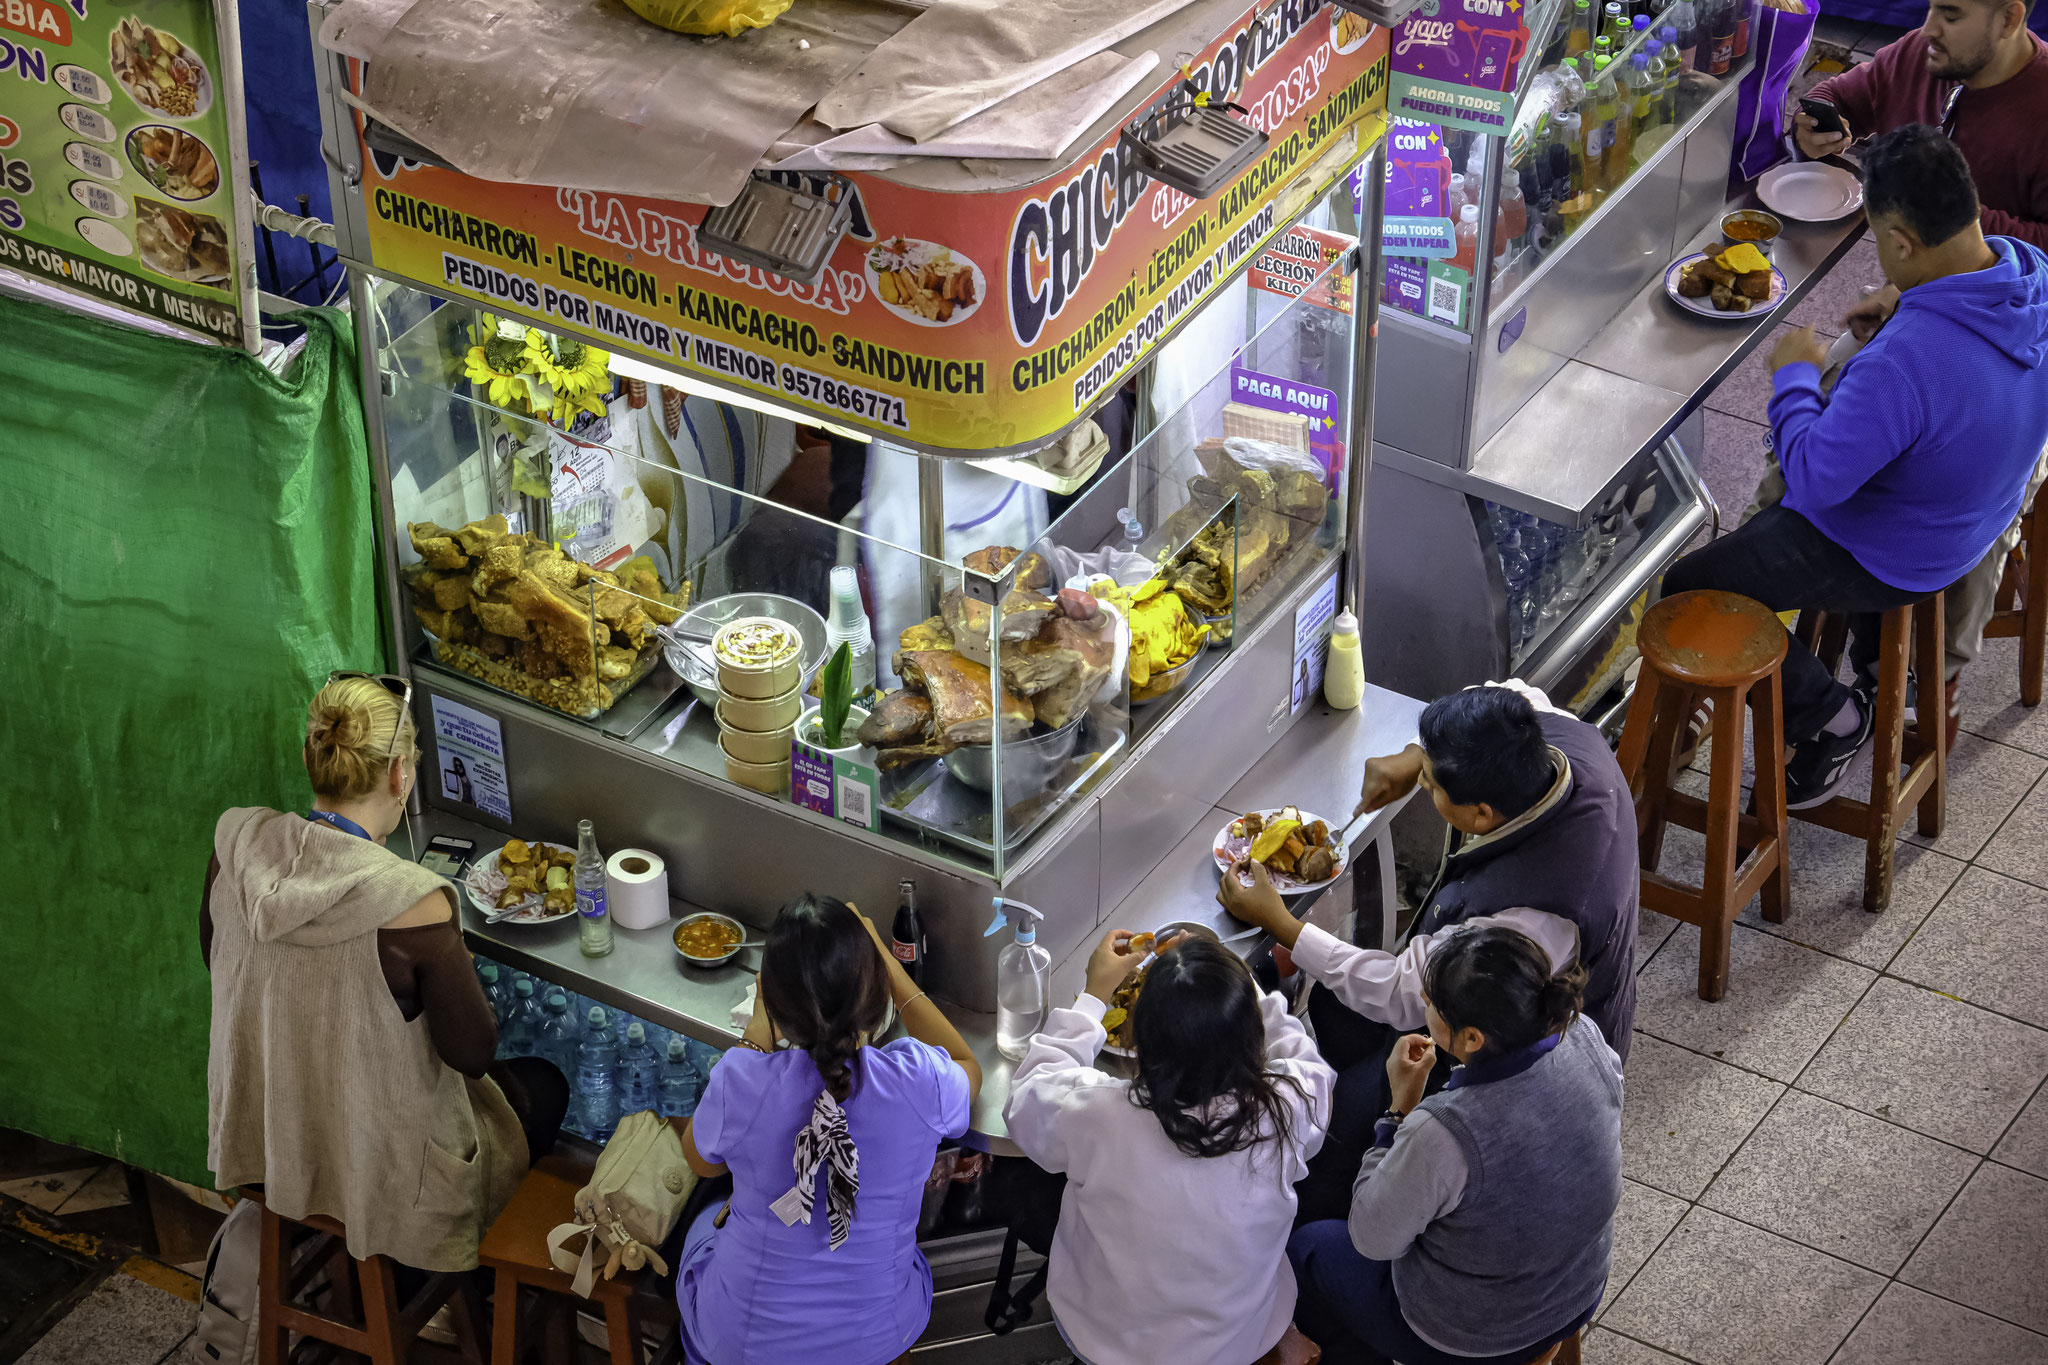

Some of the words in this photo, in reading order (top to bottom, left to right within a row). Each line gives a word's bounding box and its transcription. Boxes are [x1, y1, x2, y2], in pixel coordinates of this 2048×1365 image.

[0, 0, 60, 37] BIA
[1463, 0, 1505, 17] CON
[1396, 19, 1454, 55] yape
[1480, 66, 1496, 78] yape
[1401, 97, 1452, 118] PUEDEN
[1455, 108, 1505, 126] YAPEAR
[1408, 85, 1453, 104] AHORA
[1457, 94, 1501, 113] TODOS
[1395, 135, 1427, 150] CON
[1012, 281, 1136, 392] CHICHARRON
[1148, 214, 1208, 296] LECHON
[1307, 62, 1386, 152] SANDWICH
[1409, 225, 1444, 236] TODOS
[1409, 237, 1450, 249] YAPEAR
[1255, 255, 1316, 282] LECHÓN
[24, 244, 65, 277] POR
[69, 259, 141, 303] MAYOR
[143, 285, 156, 309] Y
[162, 292, 237, 336] MENOR
[375, 188, 540, 268] CHICHARRON
[558, 246, 657, 308] LECHON
[832, 334, 985, 395] SANDWICH
[1267, 276, 1302, 295] KILO
[1074, 332, 1134, 409] PEDIDOS
[1136, 307, 1164, 350] POR
[1167, 266, 1213, 319] MAYOR
[1215, 247, 1226, 276] Y
[1227, 209, 1274, 267] MENOR
[444, 256, 539, 307] PEDIDOS
[544, 288, 590, 325] POR
[595, 306, 672, 353] MAYOR
[676, 333, 690, 358] Y
[696, 338, 777, 387] MENOR
[782, 367, 907, 428] 957866771
[1238, 375, 1283, 400] PAGA
[1285, 388, 1329, 412] AQUÍ
[446, 721, 462, 731] que
[814, 763, 827, 775] YAPE
[1831, 749, 1857, 762] Reebok
